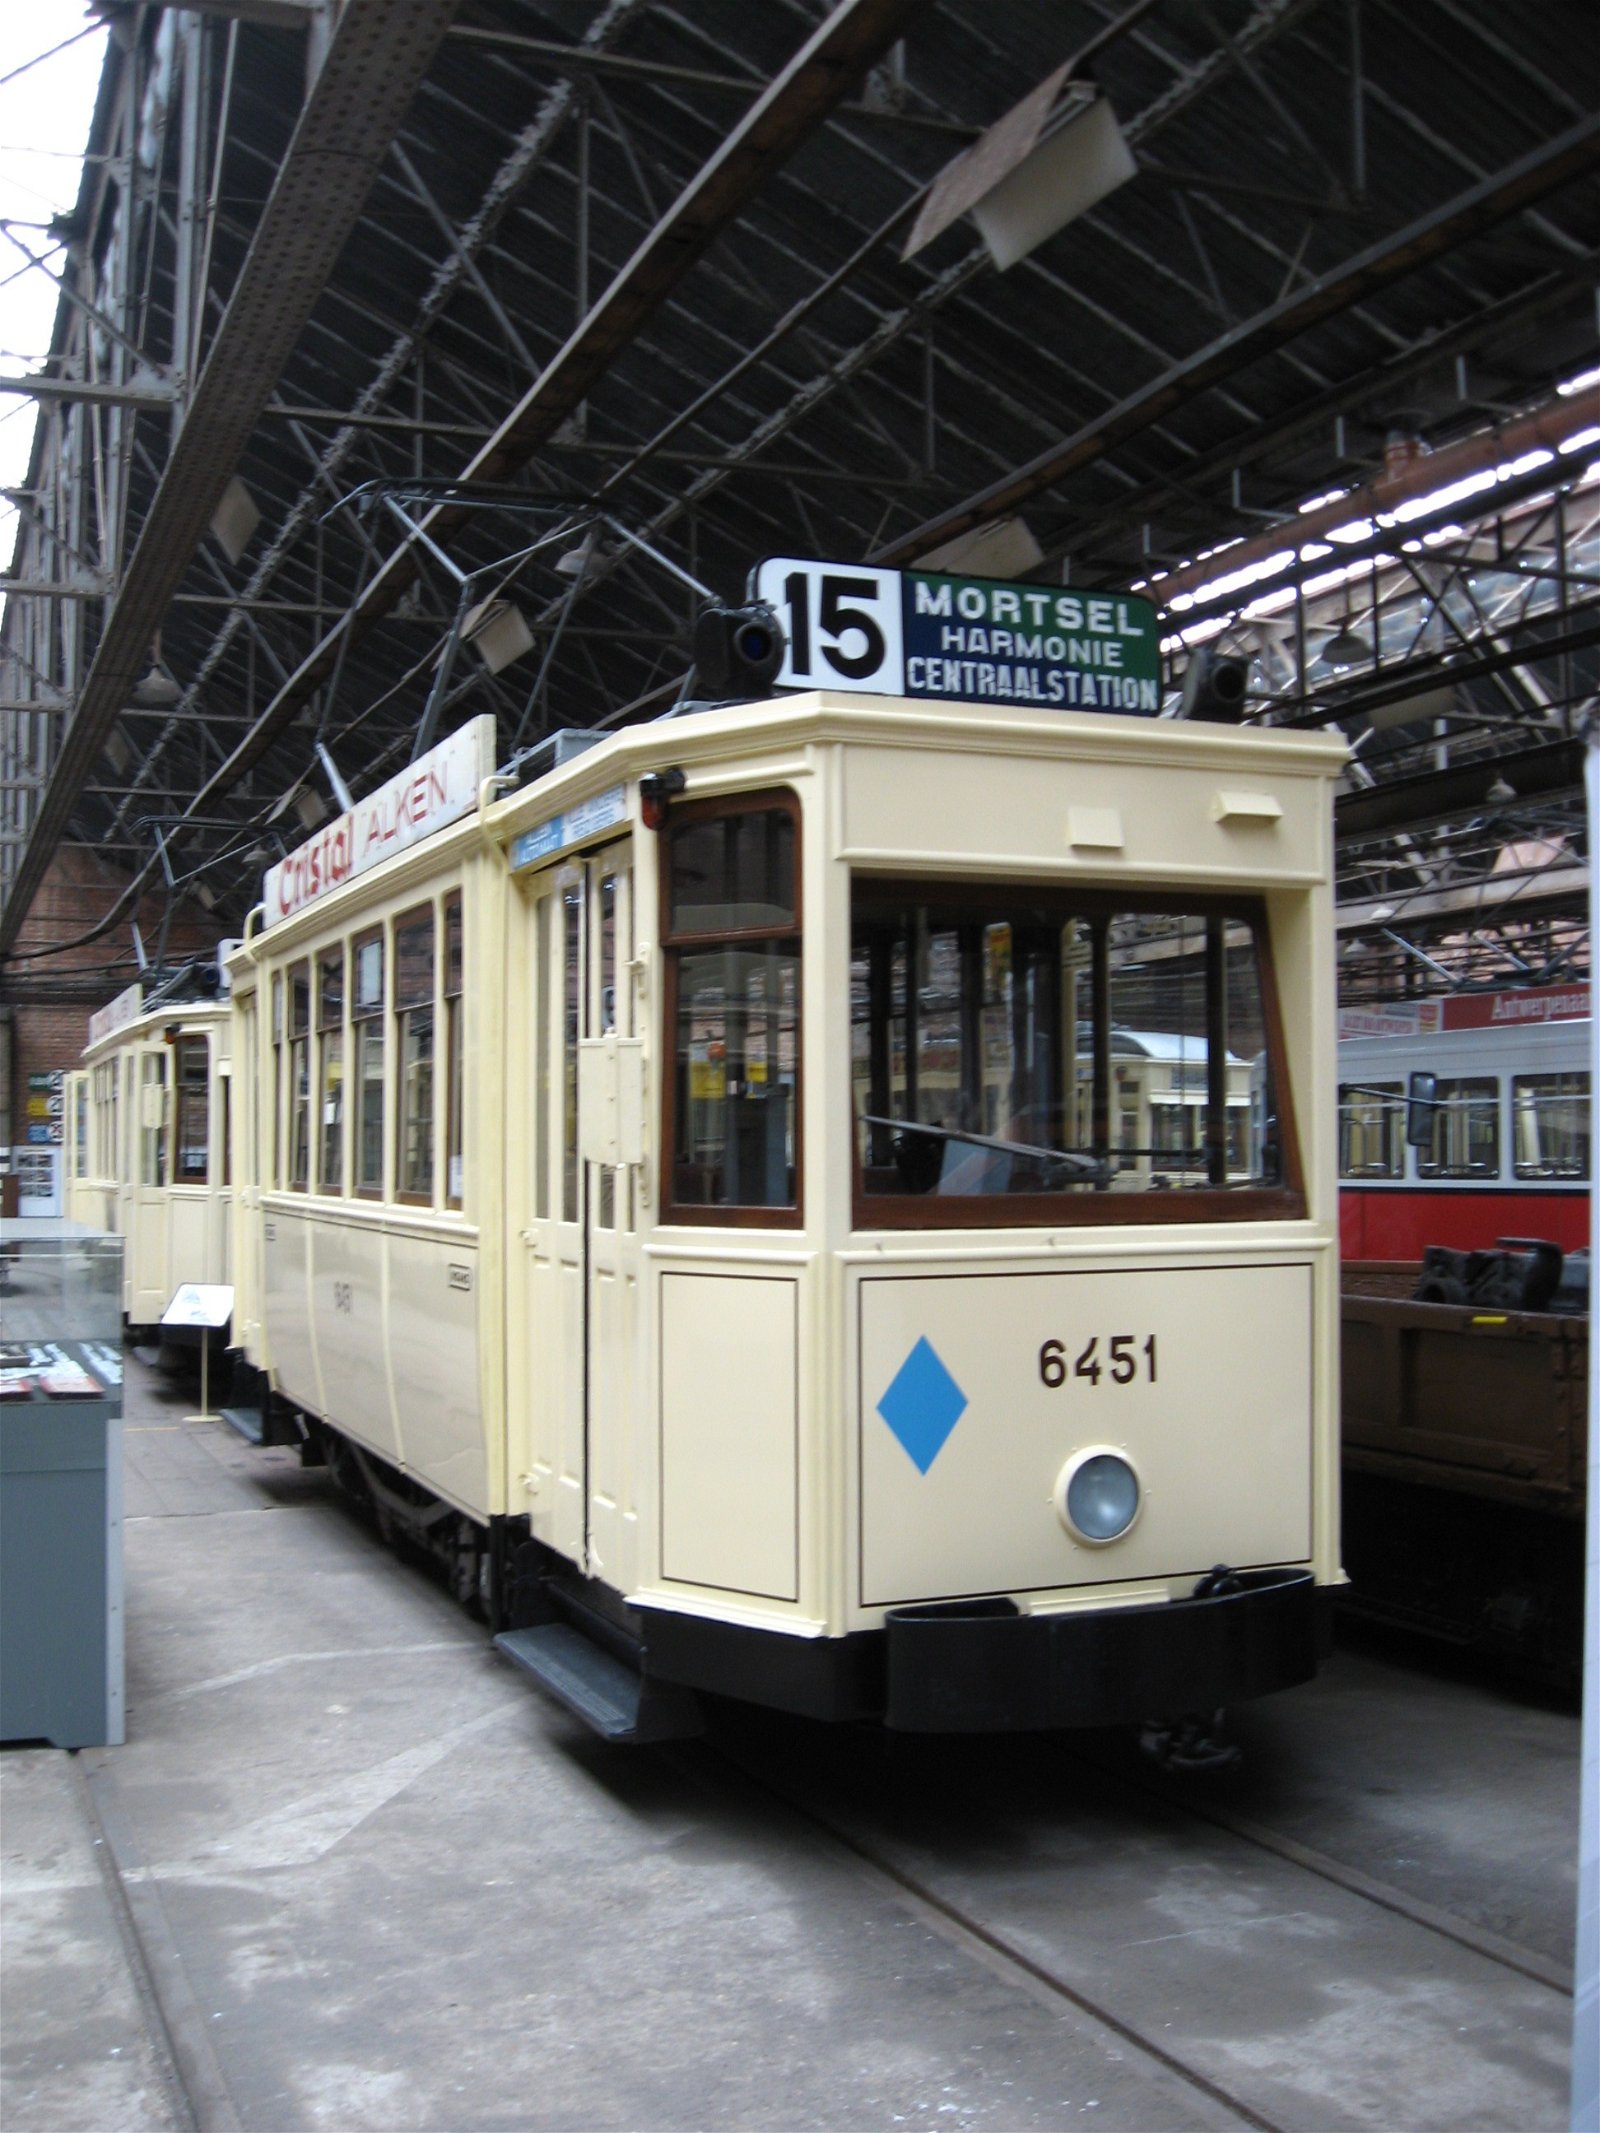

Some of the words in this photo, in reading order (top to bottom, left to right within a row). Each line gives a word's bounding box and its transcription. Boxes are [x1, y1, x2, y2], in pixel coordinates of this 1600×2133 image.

[784, 571, 886, 680] 15
[915, 581, 1144, 636] MORTSEL
[941, 625, 1124, 667] HARMONIE
[363, 761, 448, 856] ALKEN
[1038, 1334, 1157, 1388] 6451
